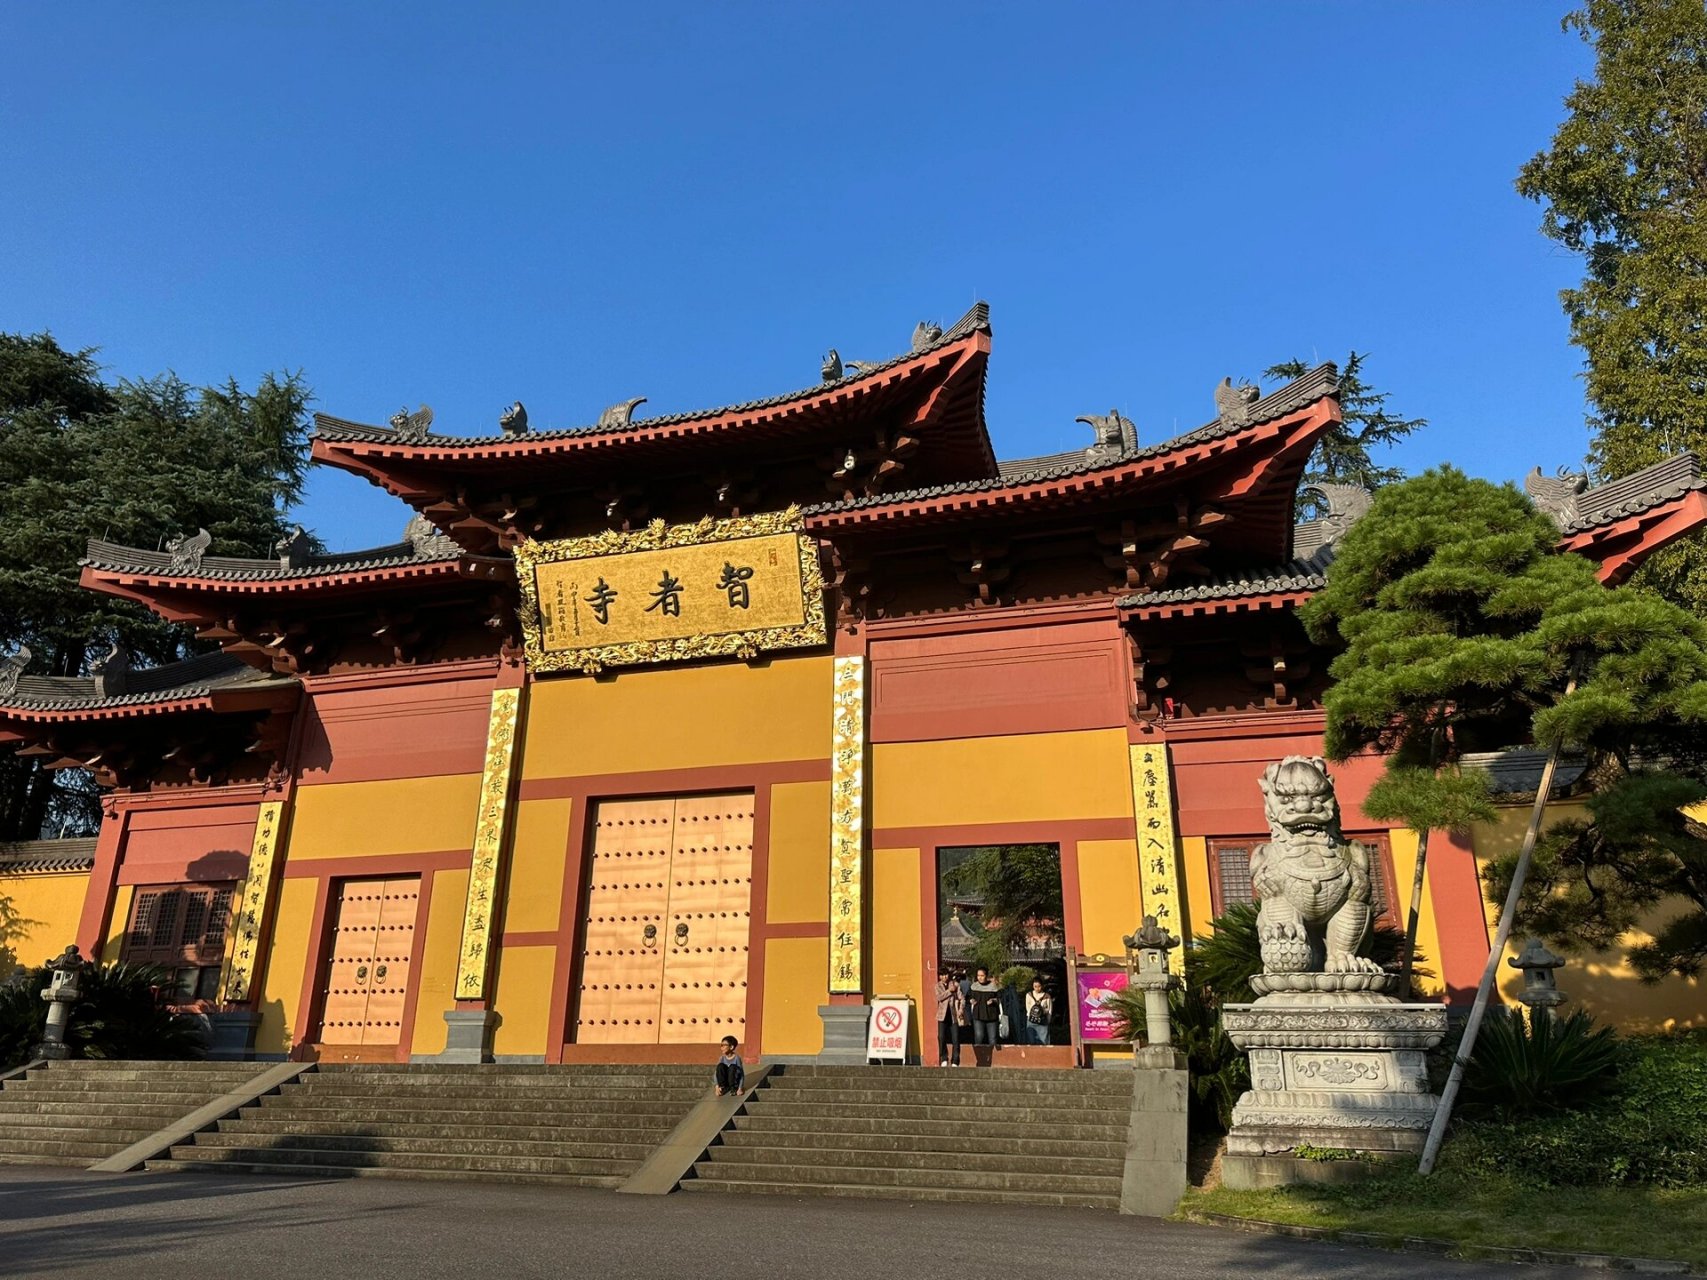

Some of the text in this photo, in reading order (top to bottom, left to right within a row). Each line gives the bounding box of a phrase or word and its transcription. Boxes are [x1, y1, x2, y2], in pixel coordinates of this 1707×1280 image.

[584, 560, 754, 625] 智者寺
[871, 1036, 903, 1049] 禁止吸烟
